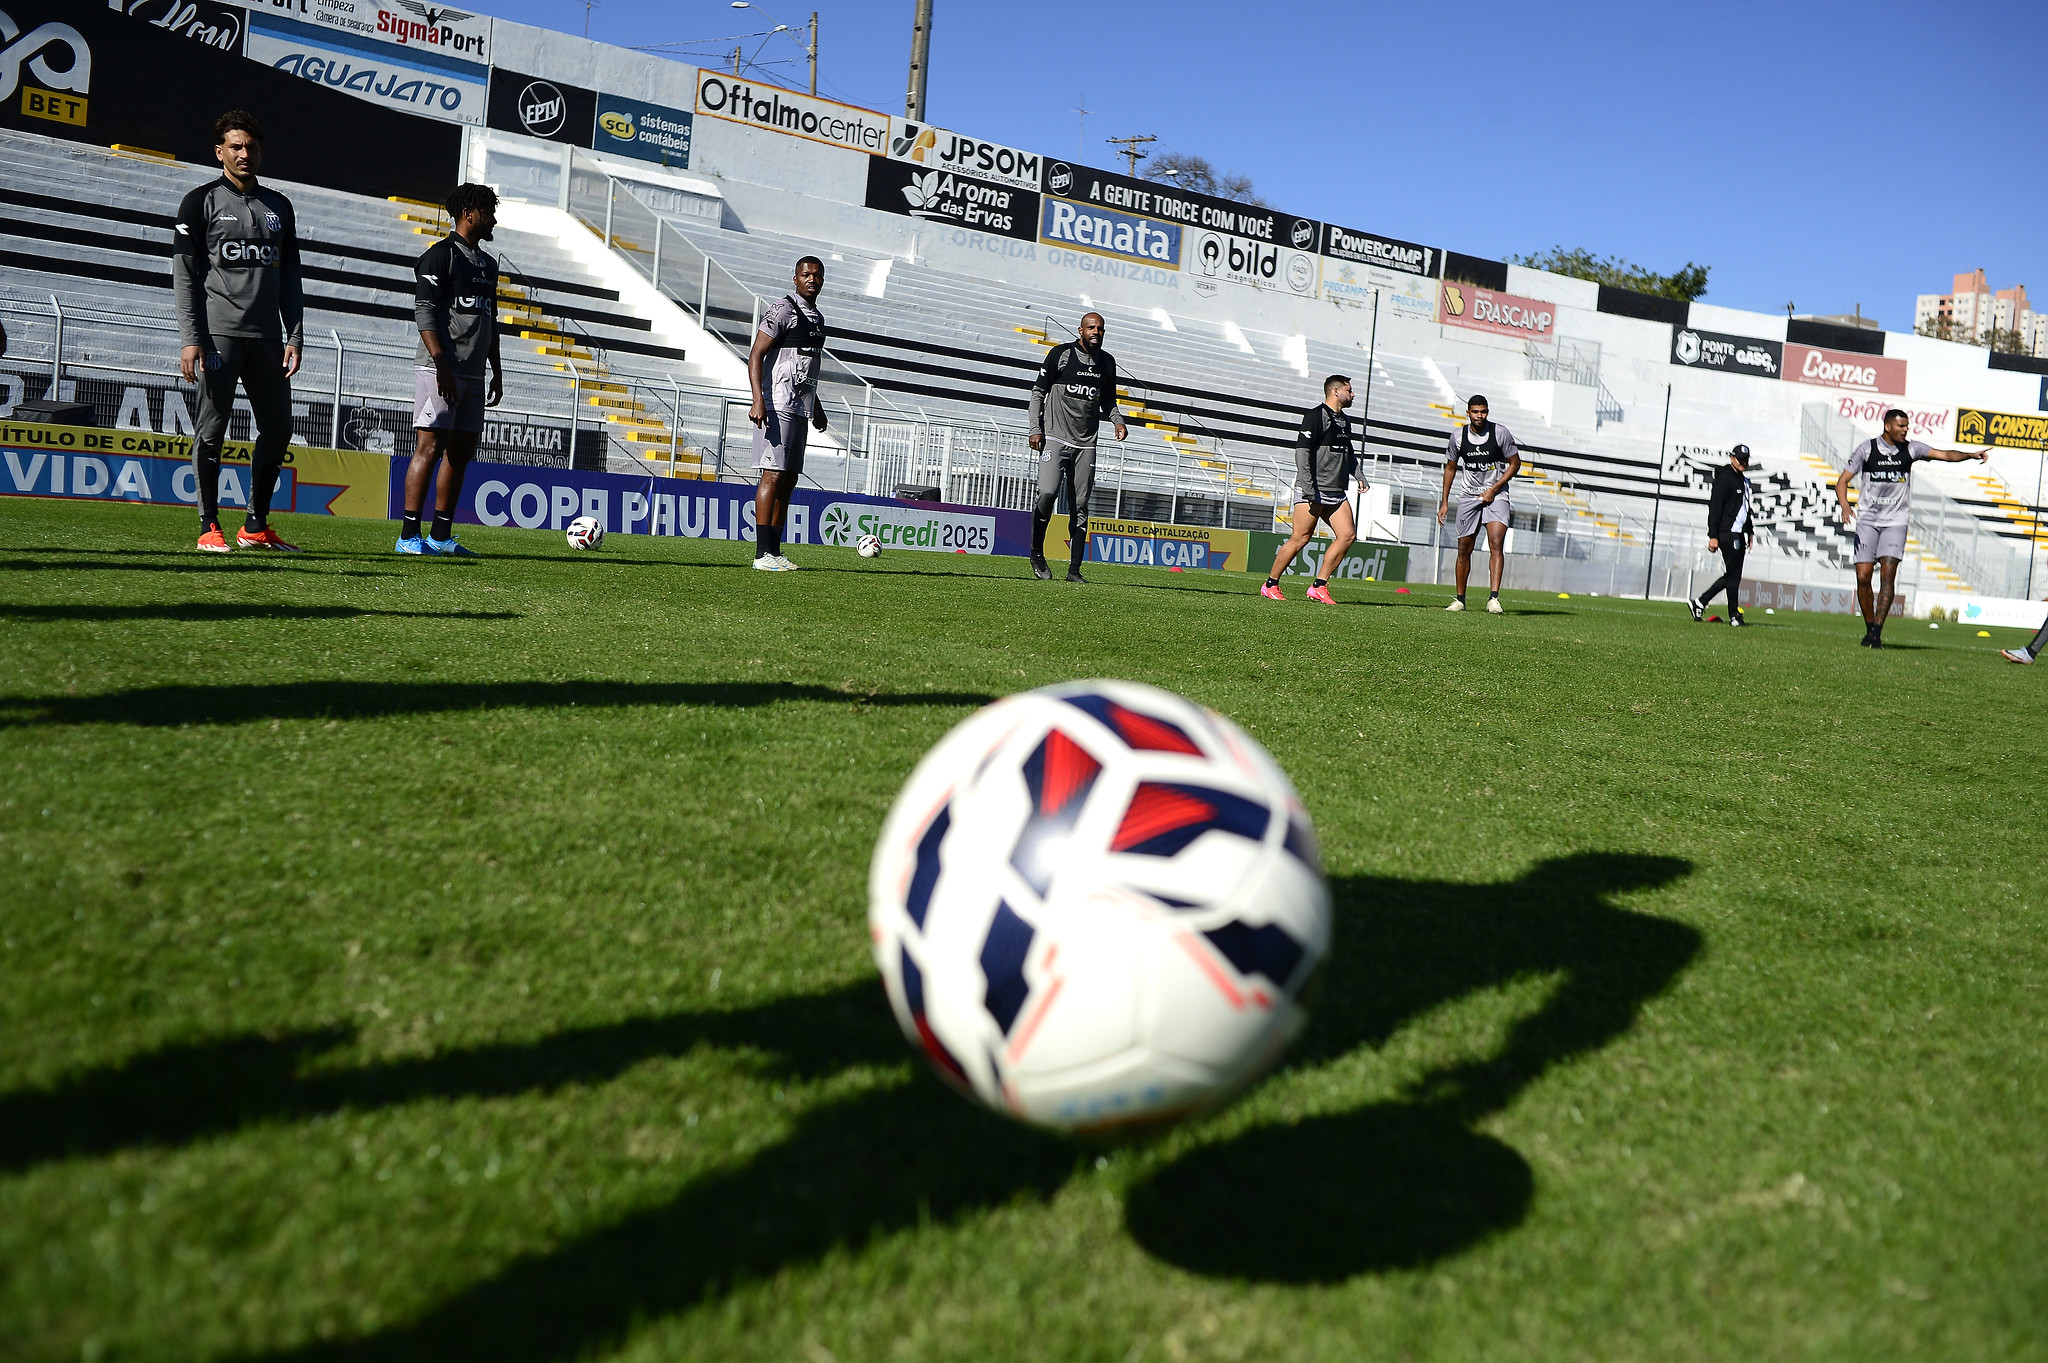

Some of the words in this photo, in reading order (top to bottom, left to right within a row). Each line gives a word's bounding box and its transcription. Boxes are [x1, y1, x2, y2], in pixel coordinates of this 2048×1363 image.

[377, 9, 484, 56] SigmaPort
[29, 93, 80, 119] BET
[701, 78, 886, 150] Oftalmocenter
[605, 119, 631, 134] SCI
[638, 130, 689, 151] contábeis
[640, 113, 691, 136] sistemas
[940, 136, 1038, 181] JPSOM
[941, 162, 988, 180] ACESSÓRIOS
[990, 174, 1038, 190] AUTOMOTIVOS
[936, 174, 1010, 209] Aroma
[940, 200, 964, 216] das
[964, 203, 1013, 231] Ervas
[1089, 180, 1101, 200] A
[1104, 184, 1150, 212] GENTE
[1153, 195, 1199, 223] TORCE
[1202, 207, 1235, 231] COM
[1238, 215, 1274, 240] VOCÊ
[1049, 200, 1171, 261] Renata
[1330, 227, 1423, 265] POWERCAMP
[936, 225, 1037, 262] TORCIDA
[1047, 249, 1180, 290] ORGANIZADA
[1228, 237, 1278, 278] bild
[1473, 299, 1552, 332] BRASCAMP
[1701, 351, 1727, 366] PLAY
[1702, 340, 1736, 356] PONTE
[1802, 350, 1877, 386] CORTAG
[0, 425, 75, 446] ÍTULO
[84, 434, 113, 449] DE
[1958, 432, 1985, 444] HC
[3, 452, 152, 499] VIDA
[172, 464, 281, 505] CA
[474, 480, 608, 532] COPA
[622, 491, 810, 544] PAULISA
[856, 514, 939, 547] Sicredi
[942, 524, 989, 550] 2025
[1090, 520, 1125, 533] TÍTULO
[1126, 526, 1139, 534] DE
[1142, 526, 1210, 540] CAPITALIZAÇÃO
[1097, 536, 1154, 565] VIDA
[1161, 541, 1205, 567] CAP
[1300, 541, 1388, 581] Siredi
